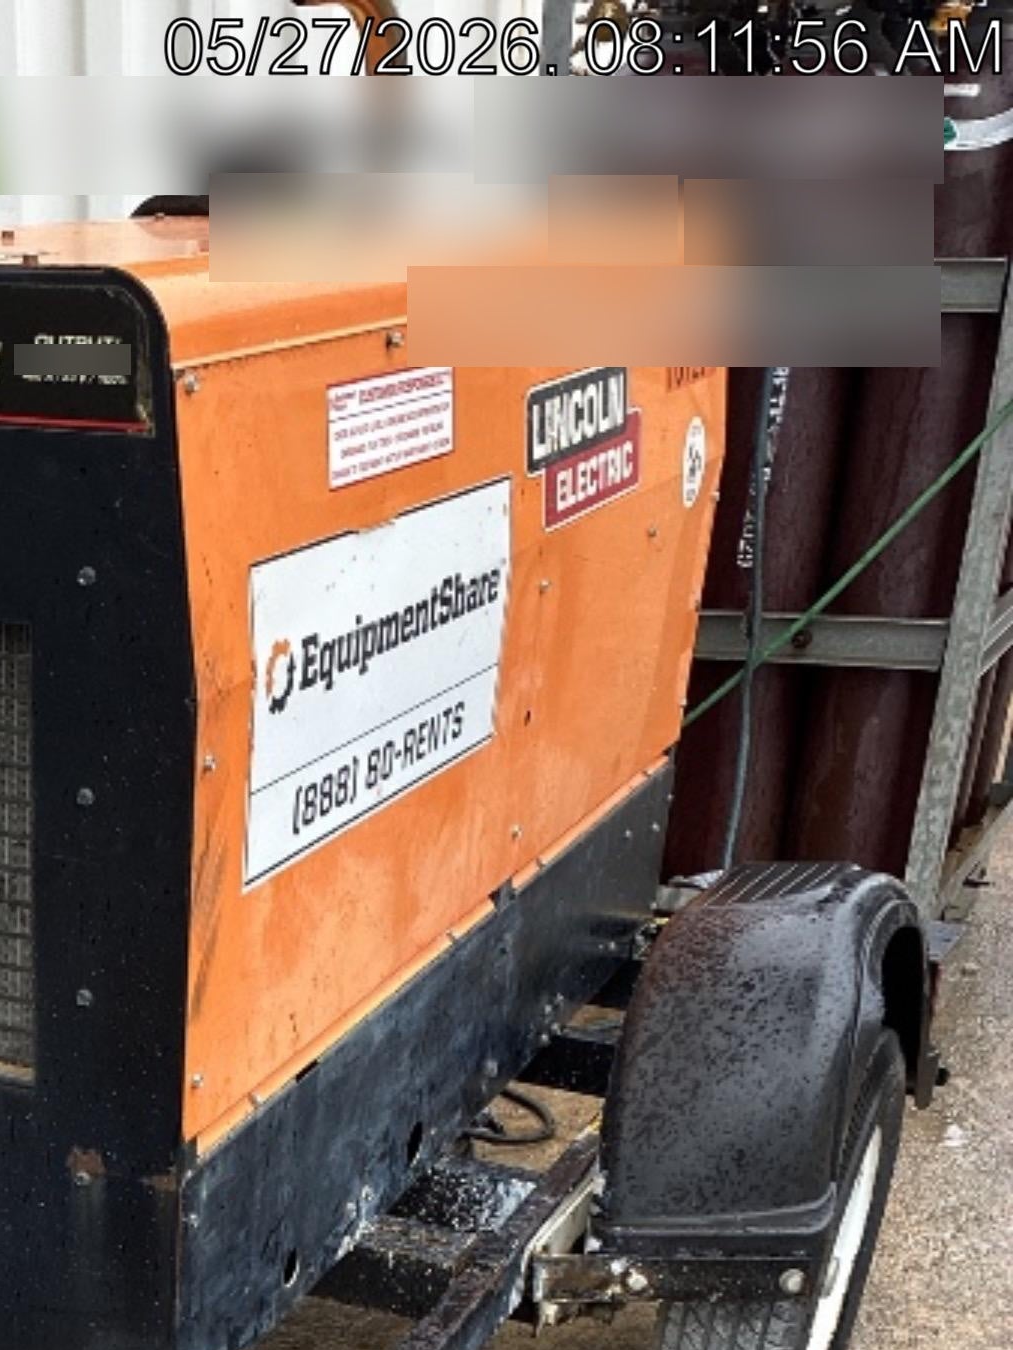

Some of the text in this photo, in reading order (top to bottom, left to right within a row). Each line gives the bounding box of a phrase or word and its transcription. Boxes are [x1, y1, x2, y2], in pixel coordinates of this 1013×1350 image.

[532, 371, 625, 460] LINCOLN
[556, 440, 633, 513] ELECTRIC
[298, 568, 500, 692] EquipmentShare
[292, 701, 465, 835] (888) 80-RENTS
